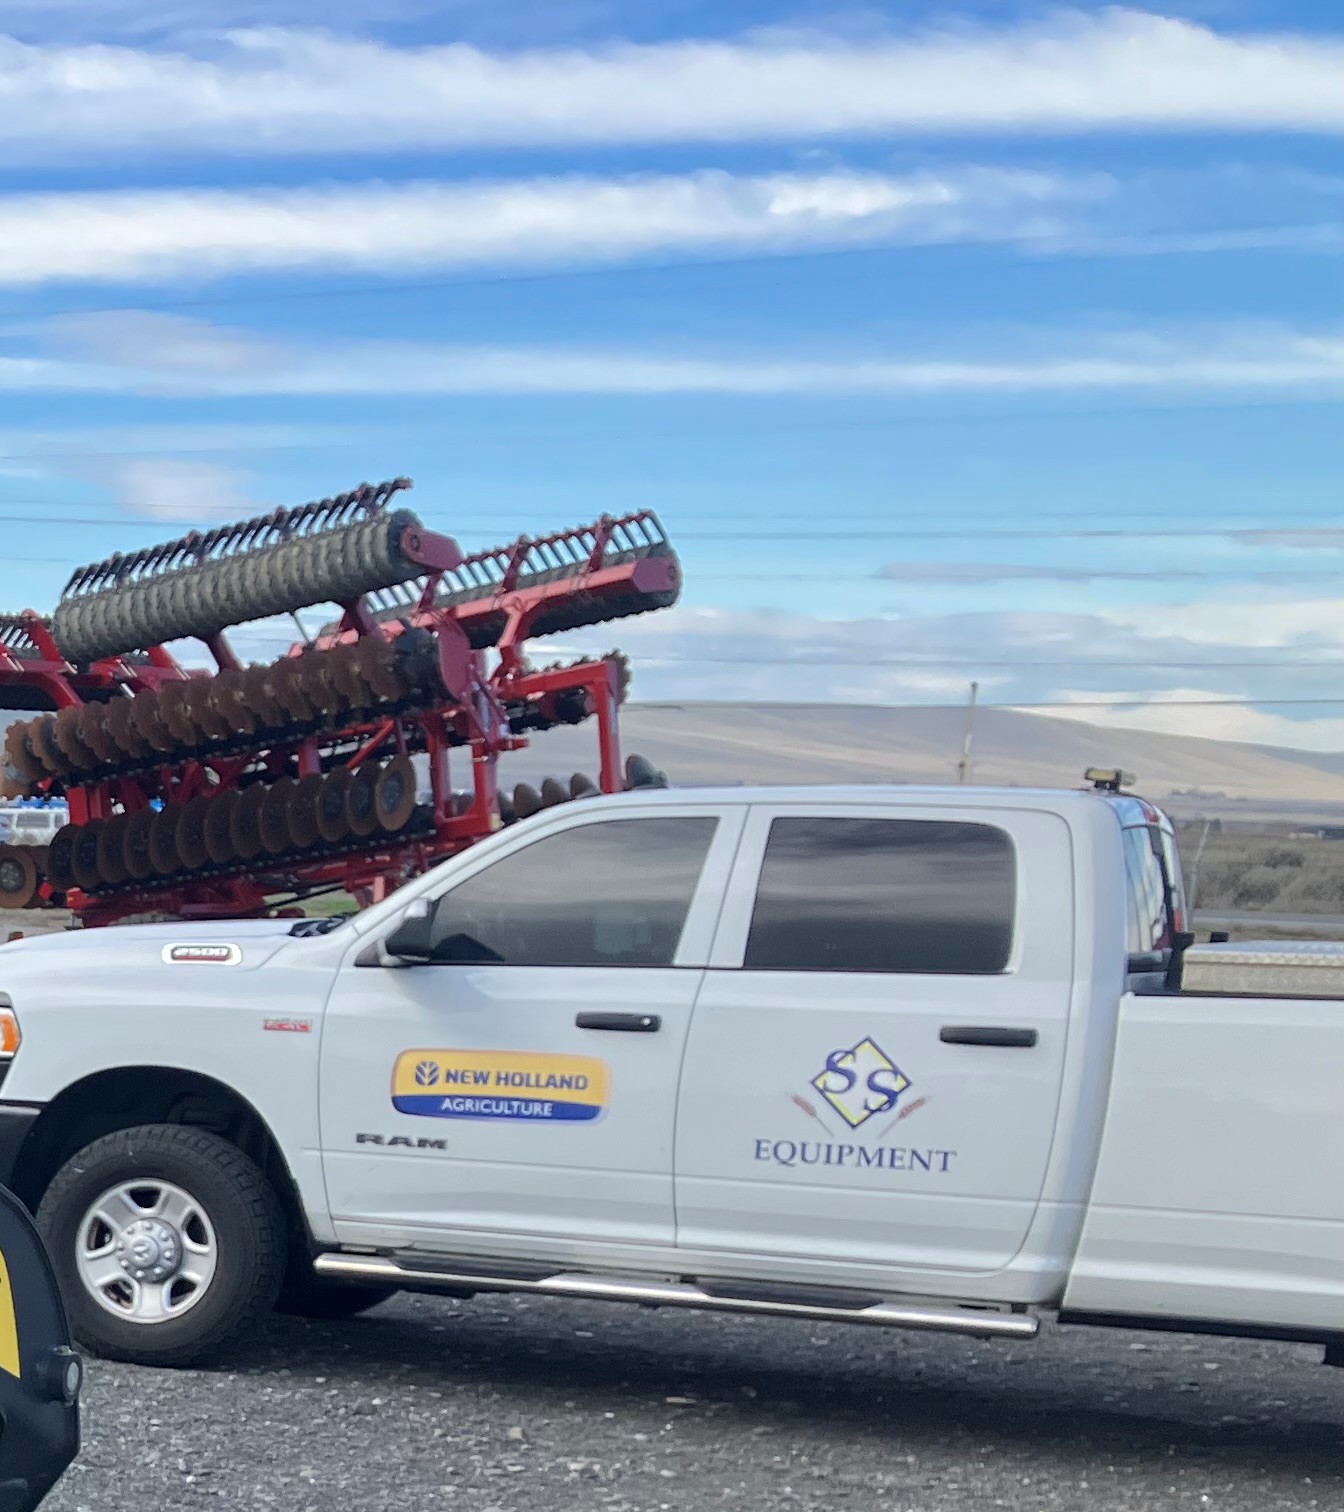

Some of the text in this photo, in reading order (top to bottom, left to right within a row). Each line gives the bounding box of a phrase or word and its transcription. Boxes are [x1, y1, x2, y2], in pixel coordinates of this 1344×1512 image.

[444, 1068, 589, 1091] NEW HOLLAND
[441, 1097, 553, 1117] AGRICULTURE
[355, 1133, 448, 1150] RAM
[754, 1138, 958, 1172] EQUIPMENT
